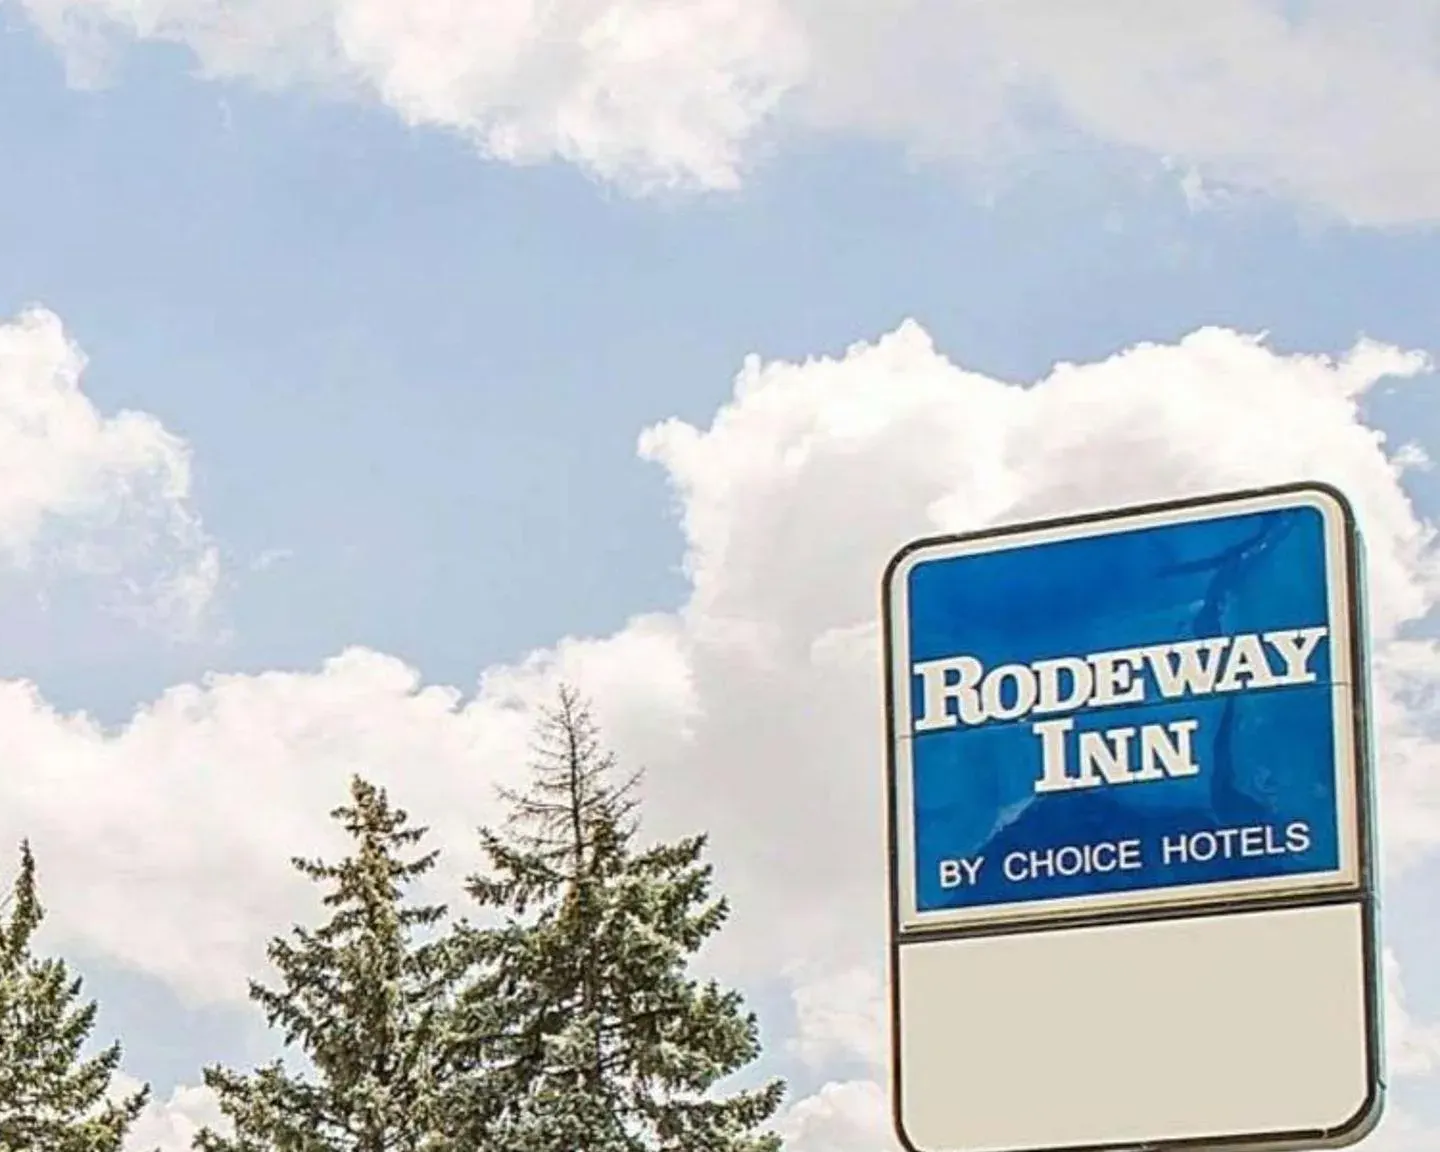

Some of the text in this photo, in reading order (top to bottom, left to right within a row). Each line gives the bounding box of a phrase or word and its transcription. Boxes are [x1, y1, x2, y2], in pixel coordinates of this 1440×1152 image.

[914, 626, 1327, 731] RODEWAY
[1034, 717, 1199, 792] INN
[940, 822, 1310, 888] BY CHOICE HOTELS
